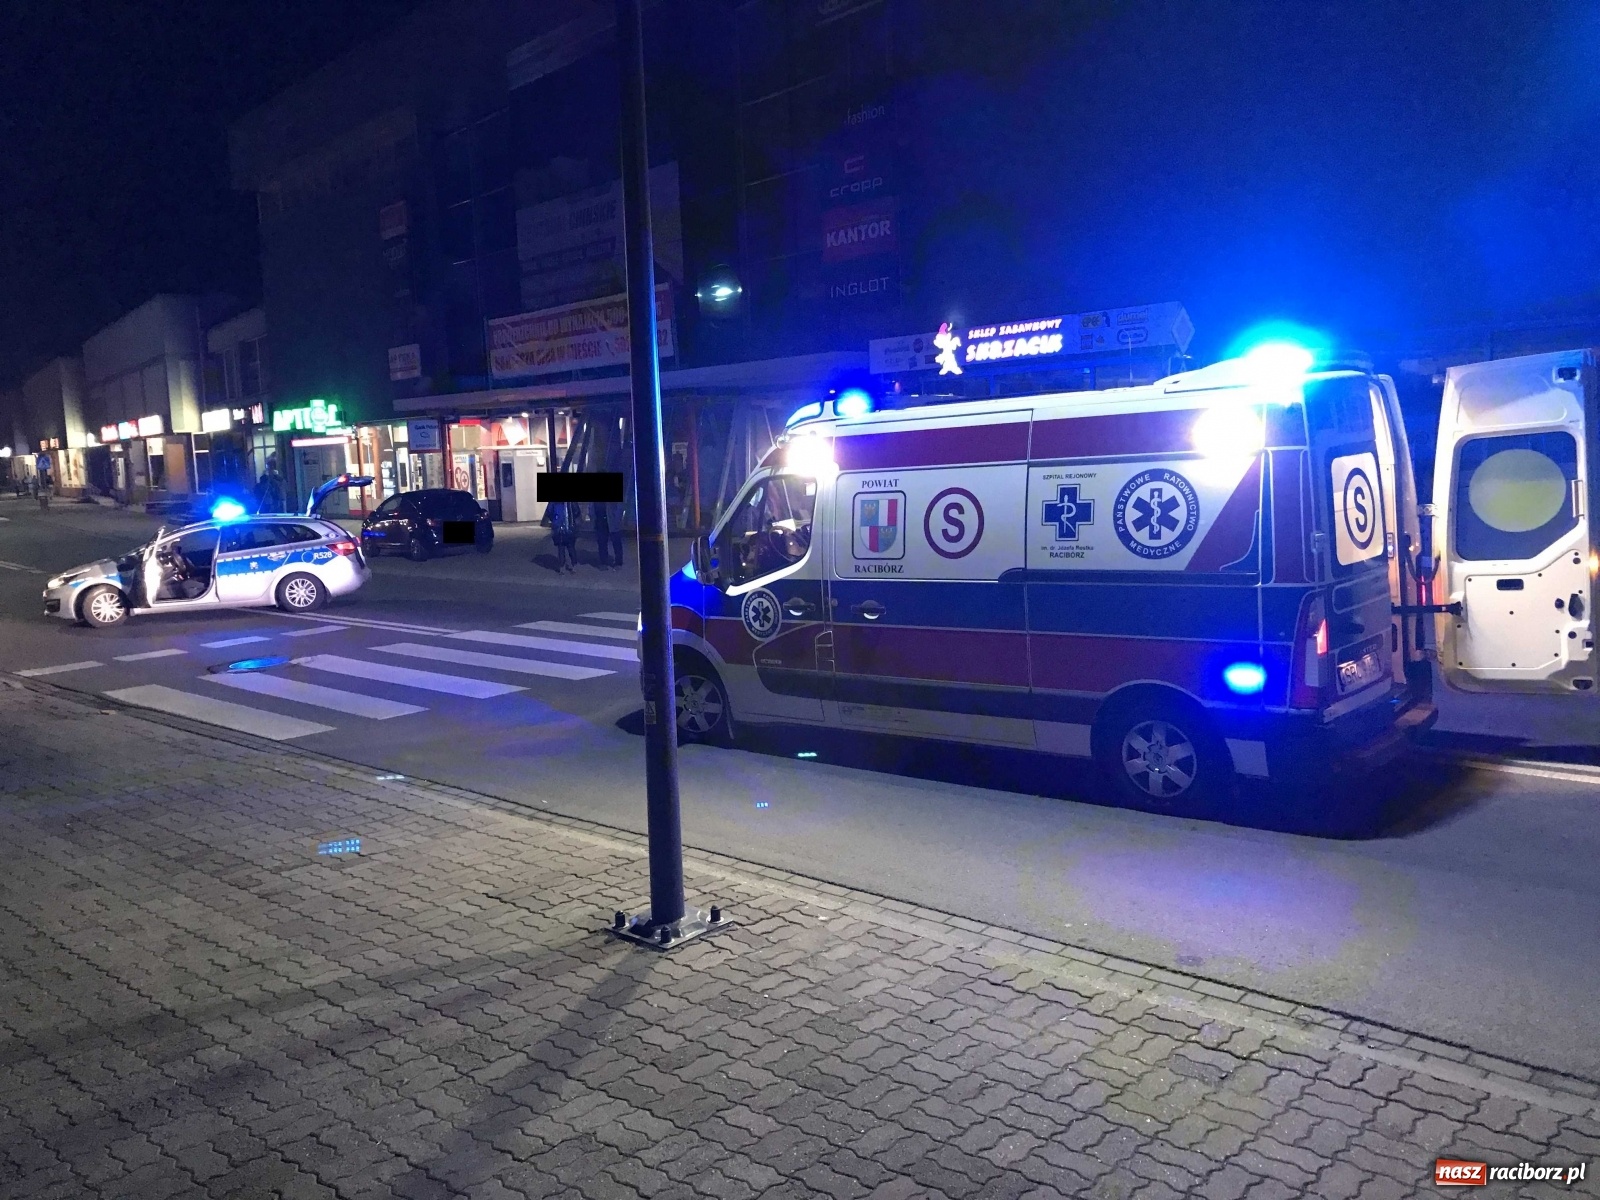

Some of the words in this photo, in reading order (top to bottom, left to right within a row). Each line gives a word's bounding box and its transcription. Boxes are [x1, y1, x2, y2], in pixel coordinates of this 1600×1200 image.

[826, 220, 891, 248] KANTOR
[830, 276, 890, 298] INGLOT
[968, 327, 997, 340] SKLEP
[998, 318, 1062, 336] ZABAWKOWY
[861, 478, 899, 488] POWIAT
[1065, 472, 1097, 480] REJONOWY
[1118, 473, 1151, 532] PAŃSTWOWE
[1163, 472, 1198, 532] RATOWNICTWO
[1353, 486, 1368, 533] S
[941, 502, 966, 544] S
[1049, 550, 1085, 559] RACIBÓRZ
[1128, 540, 1183, 556] MEDYCZNE
[854, 563, 904, 574] RACIBÓRZ
